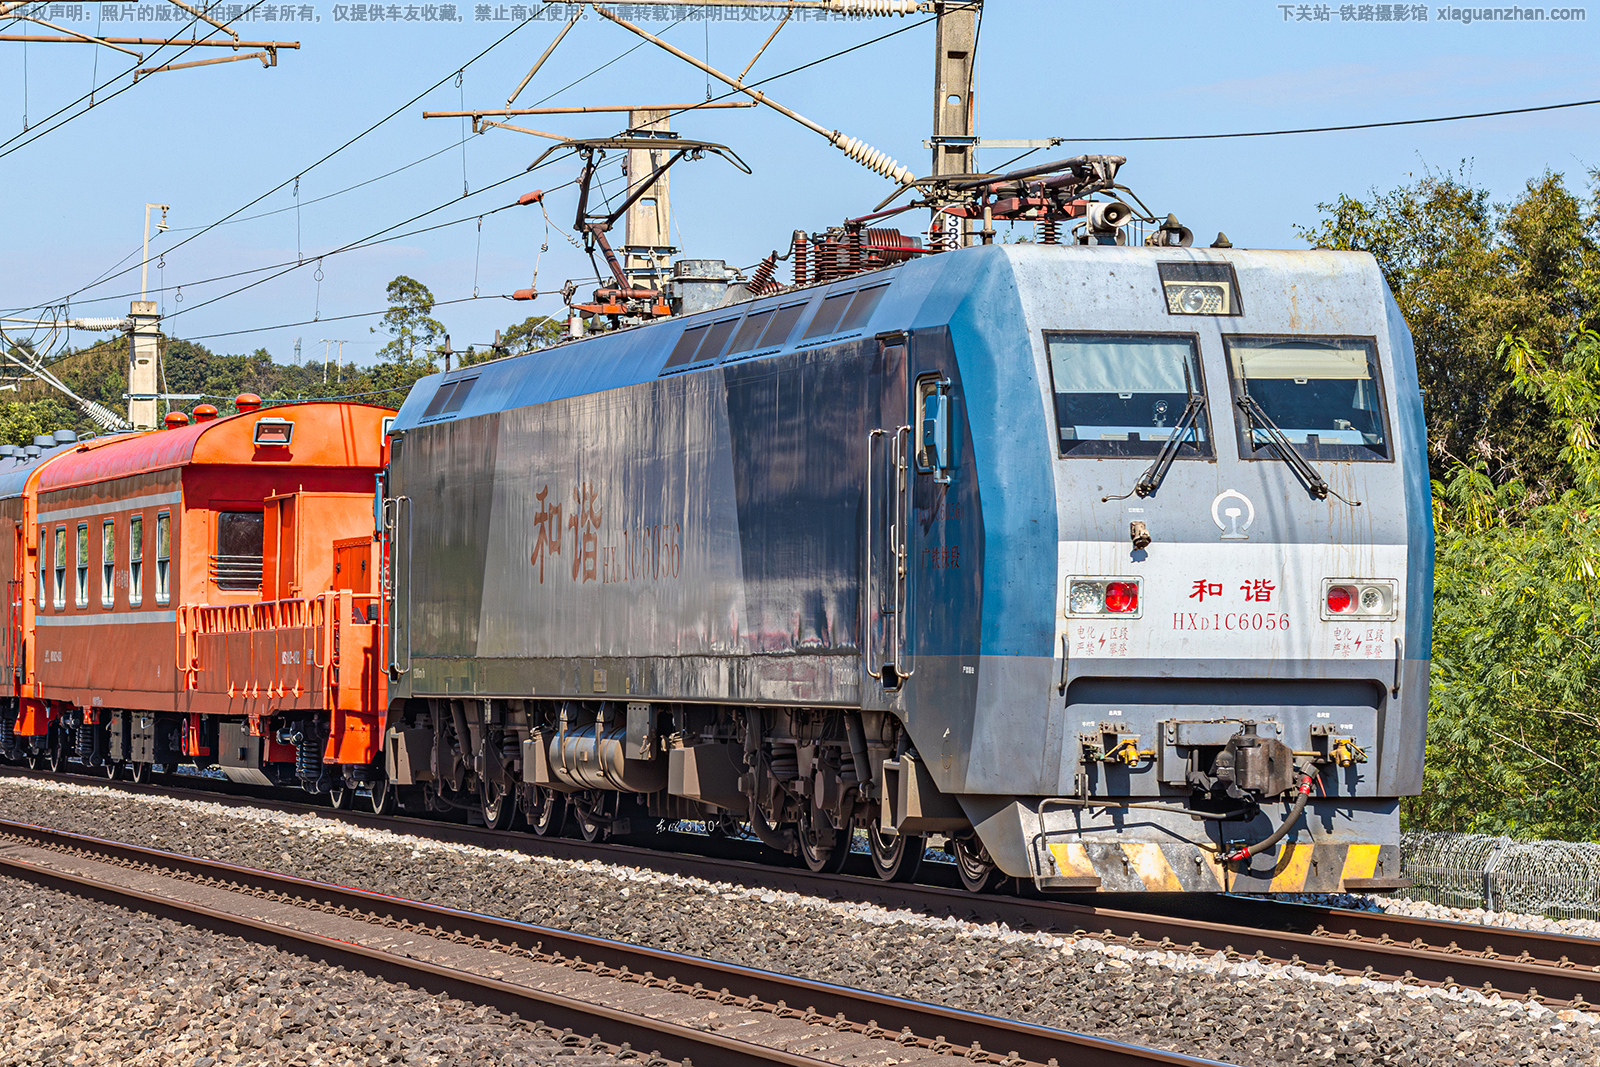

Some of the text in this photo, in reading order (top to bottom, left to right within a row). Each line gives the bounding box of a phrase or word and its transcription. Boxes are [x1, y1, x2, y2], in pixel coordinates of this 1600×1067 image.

[531, 479, 602, 584] 和谐
[1189, 579, 1276, 602] 和谐
[1173, 613, 1290, 630] HXD1C6056
